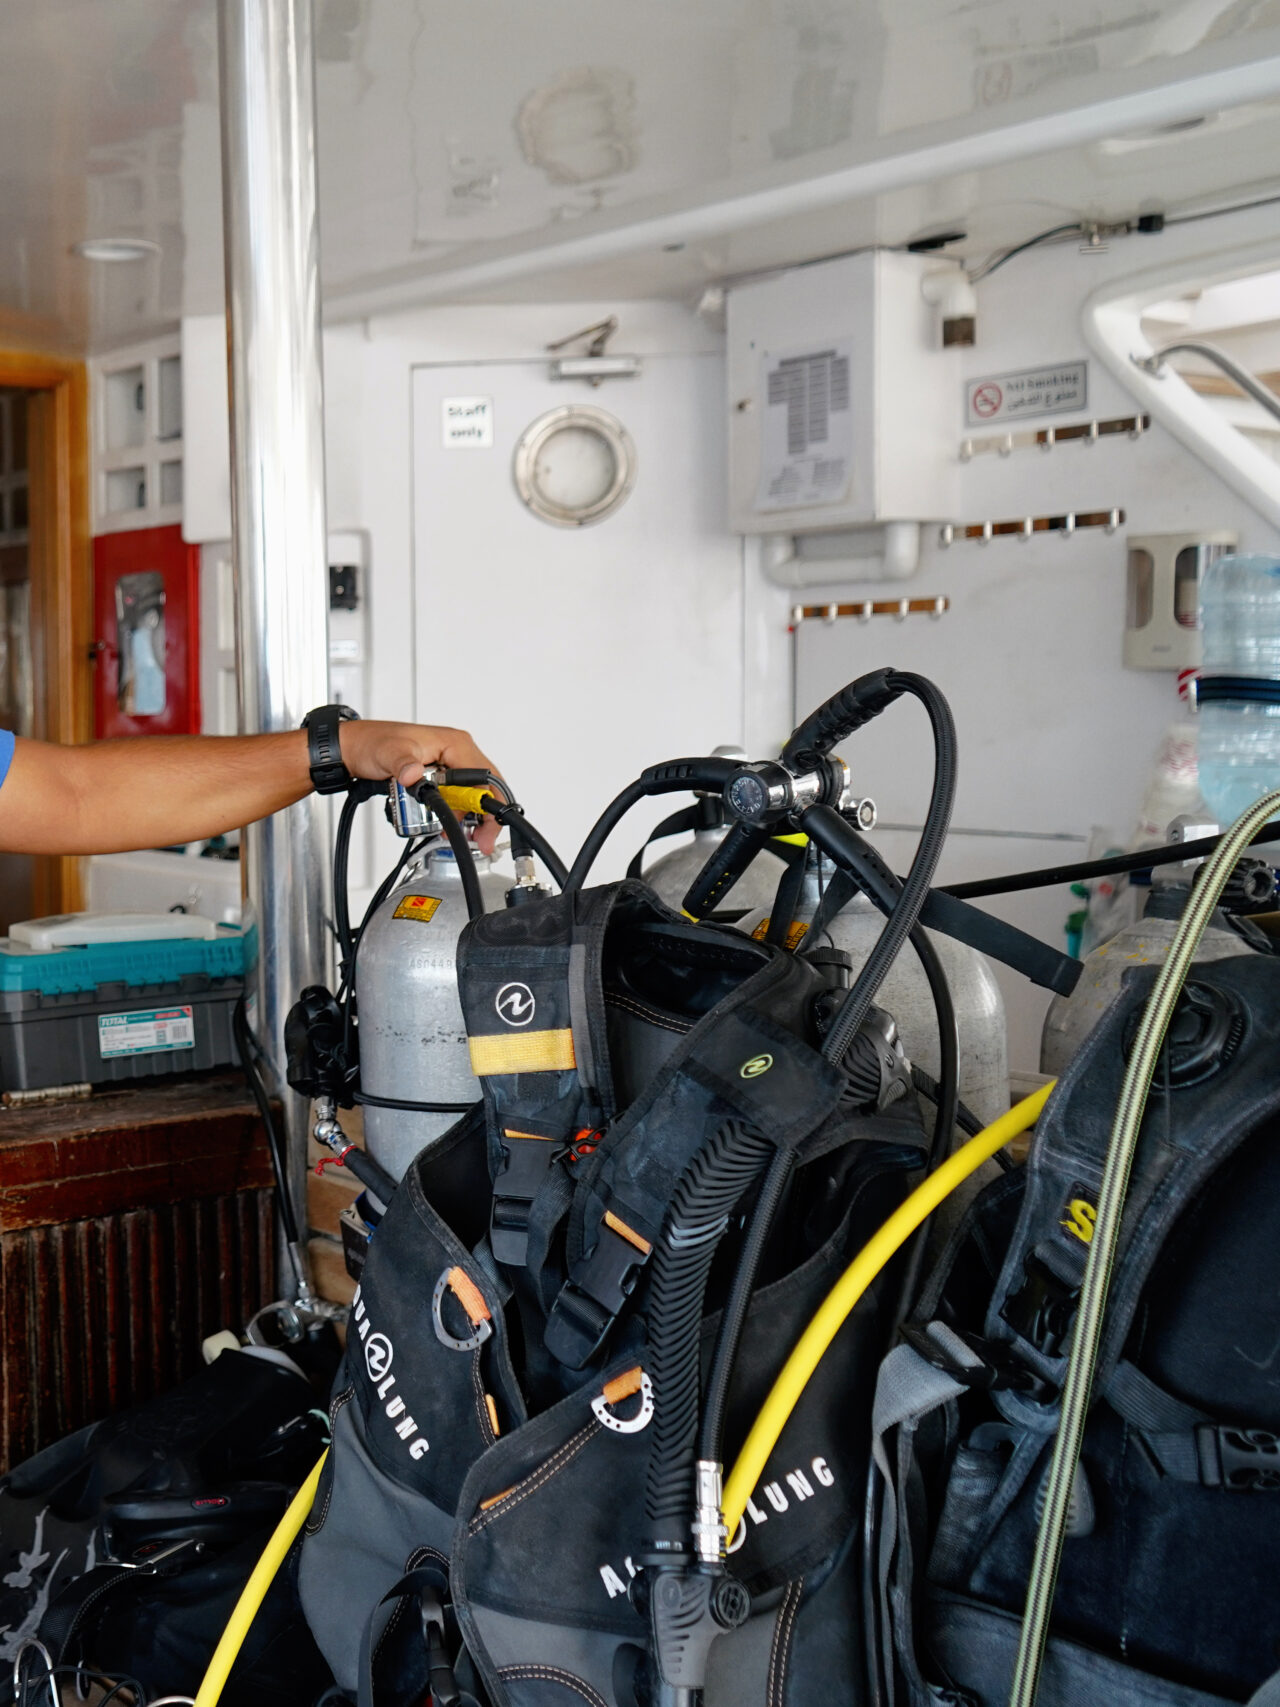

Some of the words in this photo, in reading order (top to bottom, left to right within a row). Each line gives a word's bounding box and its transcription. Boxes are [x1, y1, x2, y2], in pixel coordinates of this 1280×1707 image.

[101, 1016, 129, 1027] TOTAL
[377, 1374, 430, 1460] LUNG
[746, 1456, 835, 1525] LUNG
